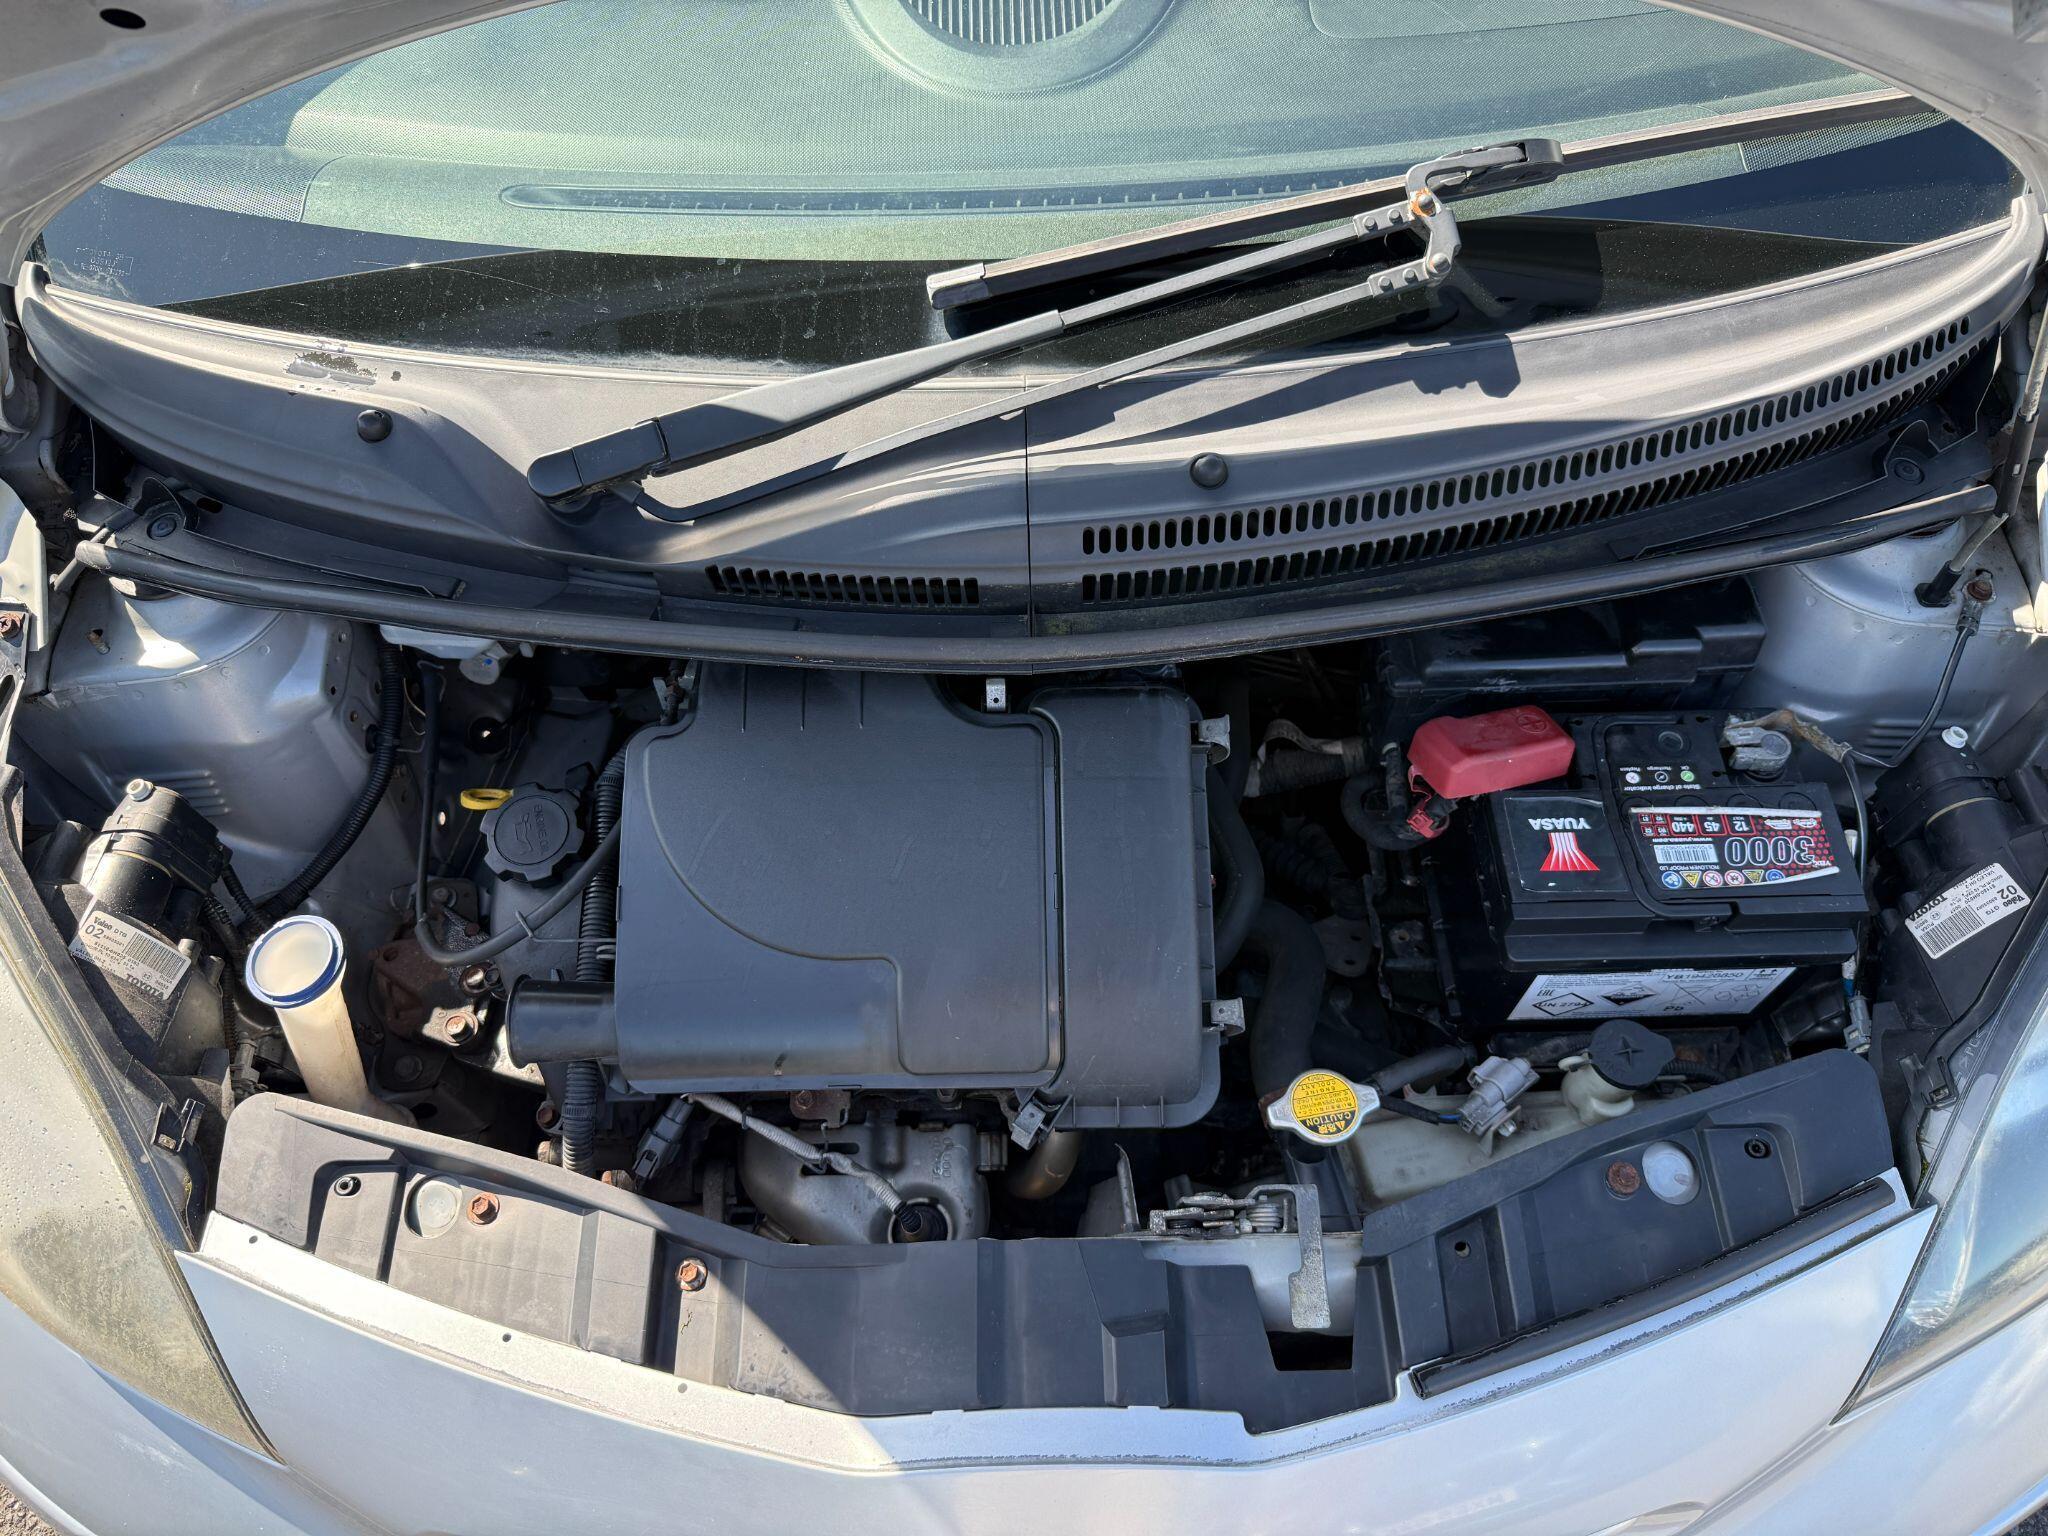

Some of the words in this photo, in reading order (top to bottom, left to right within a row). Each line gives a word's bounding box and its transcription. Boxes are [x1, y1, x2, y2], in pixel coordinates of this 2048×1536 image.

[534, 804, 548, 840] ENGINE
[1528, 818, 1592, 830] YUASA
[1672, 822, 1694, 833] 440
[1704, 821, 1720, 832] 45
[1732, 821, 1750, 832] 12
[1724, 836, 1816, 866] 3000
[1997, 885, 2017, 900] 02
[2002, 894, 2025, 907] Valeo
[1908, 894, 1948, 922] TOYOTA
[94, 916, 112, 930] Valeo
[85, 924, 104, 939] 02
[126, 973, 164, 1000] TOYOTA
[1301, 1080, 1336, 1090] COOLANT
[1305, 1086, 1336, 1096] ENGINE
[1306, 1112, 1352, 1127] CAUTION
